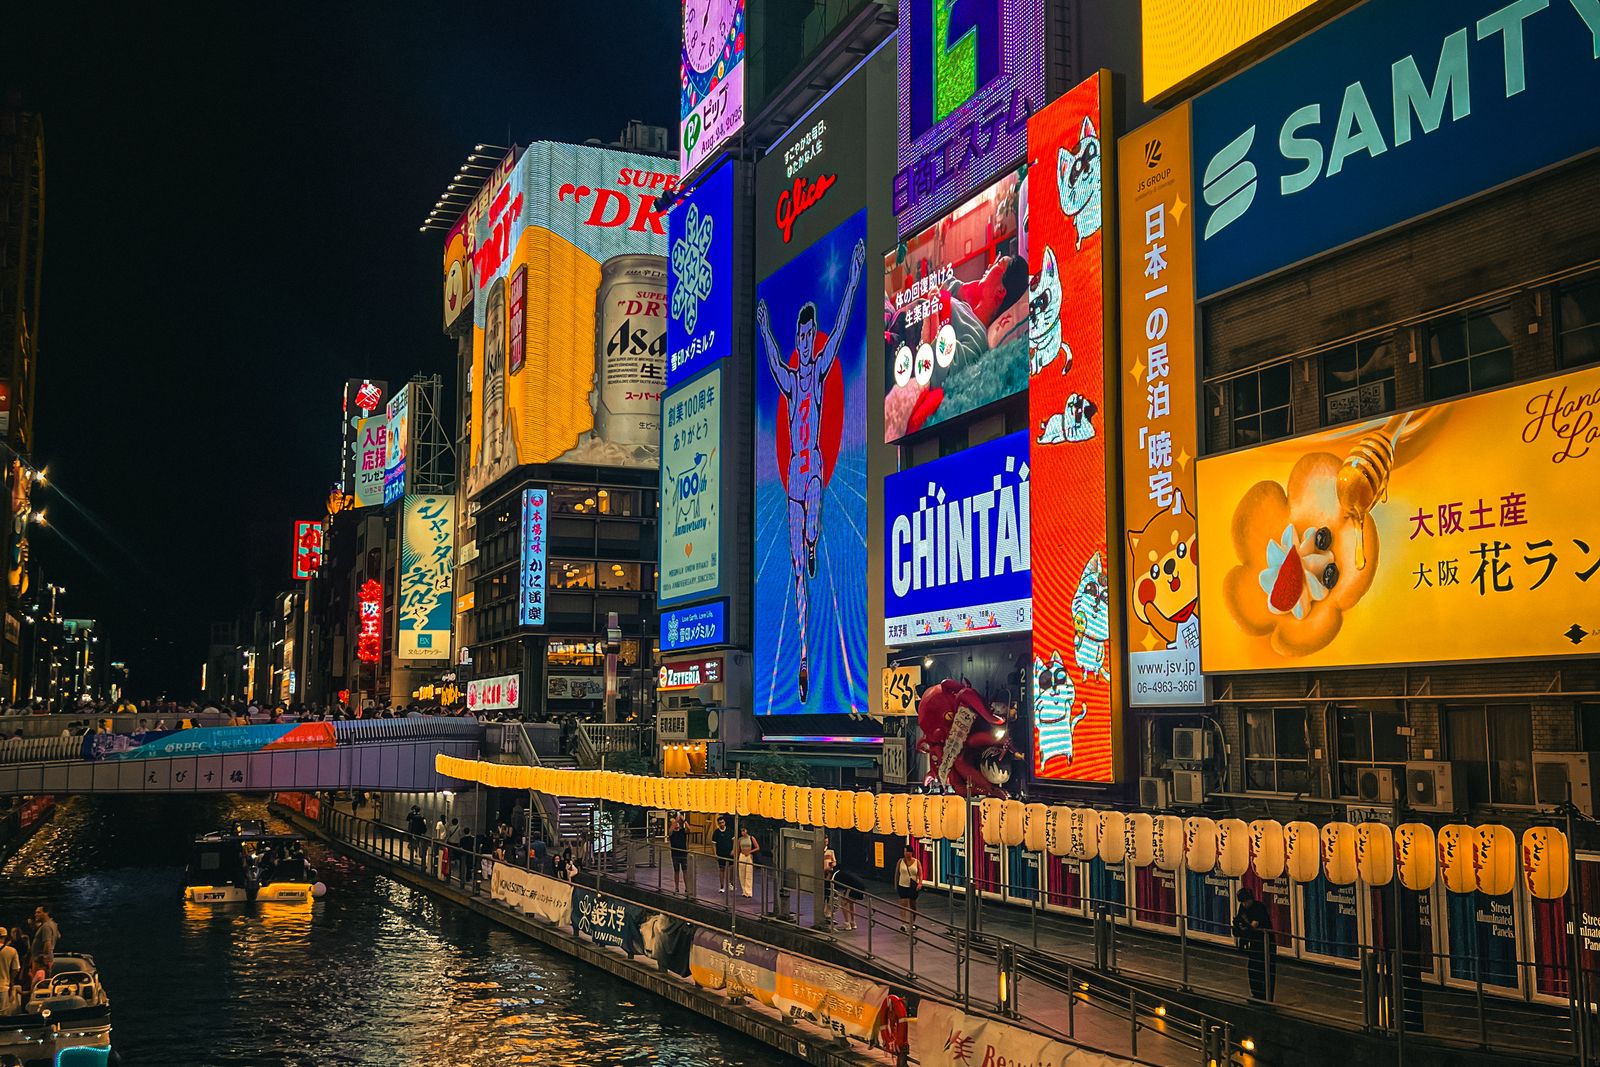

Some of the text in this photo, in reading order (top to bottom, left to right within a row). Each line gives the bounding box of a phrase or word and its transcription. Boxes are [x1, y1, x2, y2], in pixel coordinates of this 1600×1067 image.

[703, 83, 730, 131] ピップ
[701, 132, 716, 155] Aug.
[725, 105, 743, 131] 2025
[617, 167, 681, 192] SUPE
[1146, 168, 1171, 188] GROUP
[776, 174, 837, 244] Glico
[895, 263, 954, 311] 体の回復助ける
[905, 290, 943, 329] 生薬配合。
[670, 330, 716, 372] 雪印メグミルク
[640, 363, 662, 379] 生
[667, 386, 715, 428] 創業100周年
[673, 418, 709, 451] ありがとう
[799, 393, 811, 475] グリコ
[892, 460, 1030, 598] CHINTAI
[1409, 492, 1529, 541] 大阪土産
[528, 558, 543, 620] かに道楽
[1412, 558, 1460, 590] 大阪
[680, 623, 716, 643] 雪印メグミルク
[888, 624, 908, 639] 天気予報
[667, 669, 701, 686] ZETTERIA
[1137, 656, 1196, 676] www.jsv.jp
[1137, 679, 1198, 694] 06-4963-3661
[147, 769, 245, 785] えびす橋
[1490, 900, 1511, 914] Street
